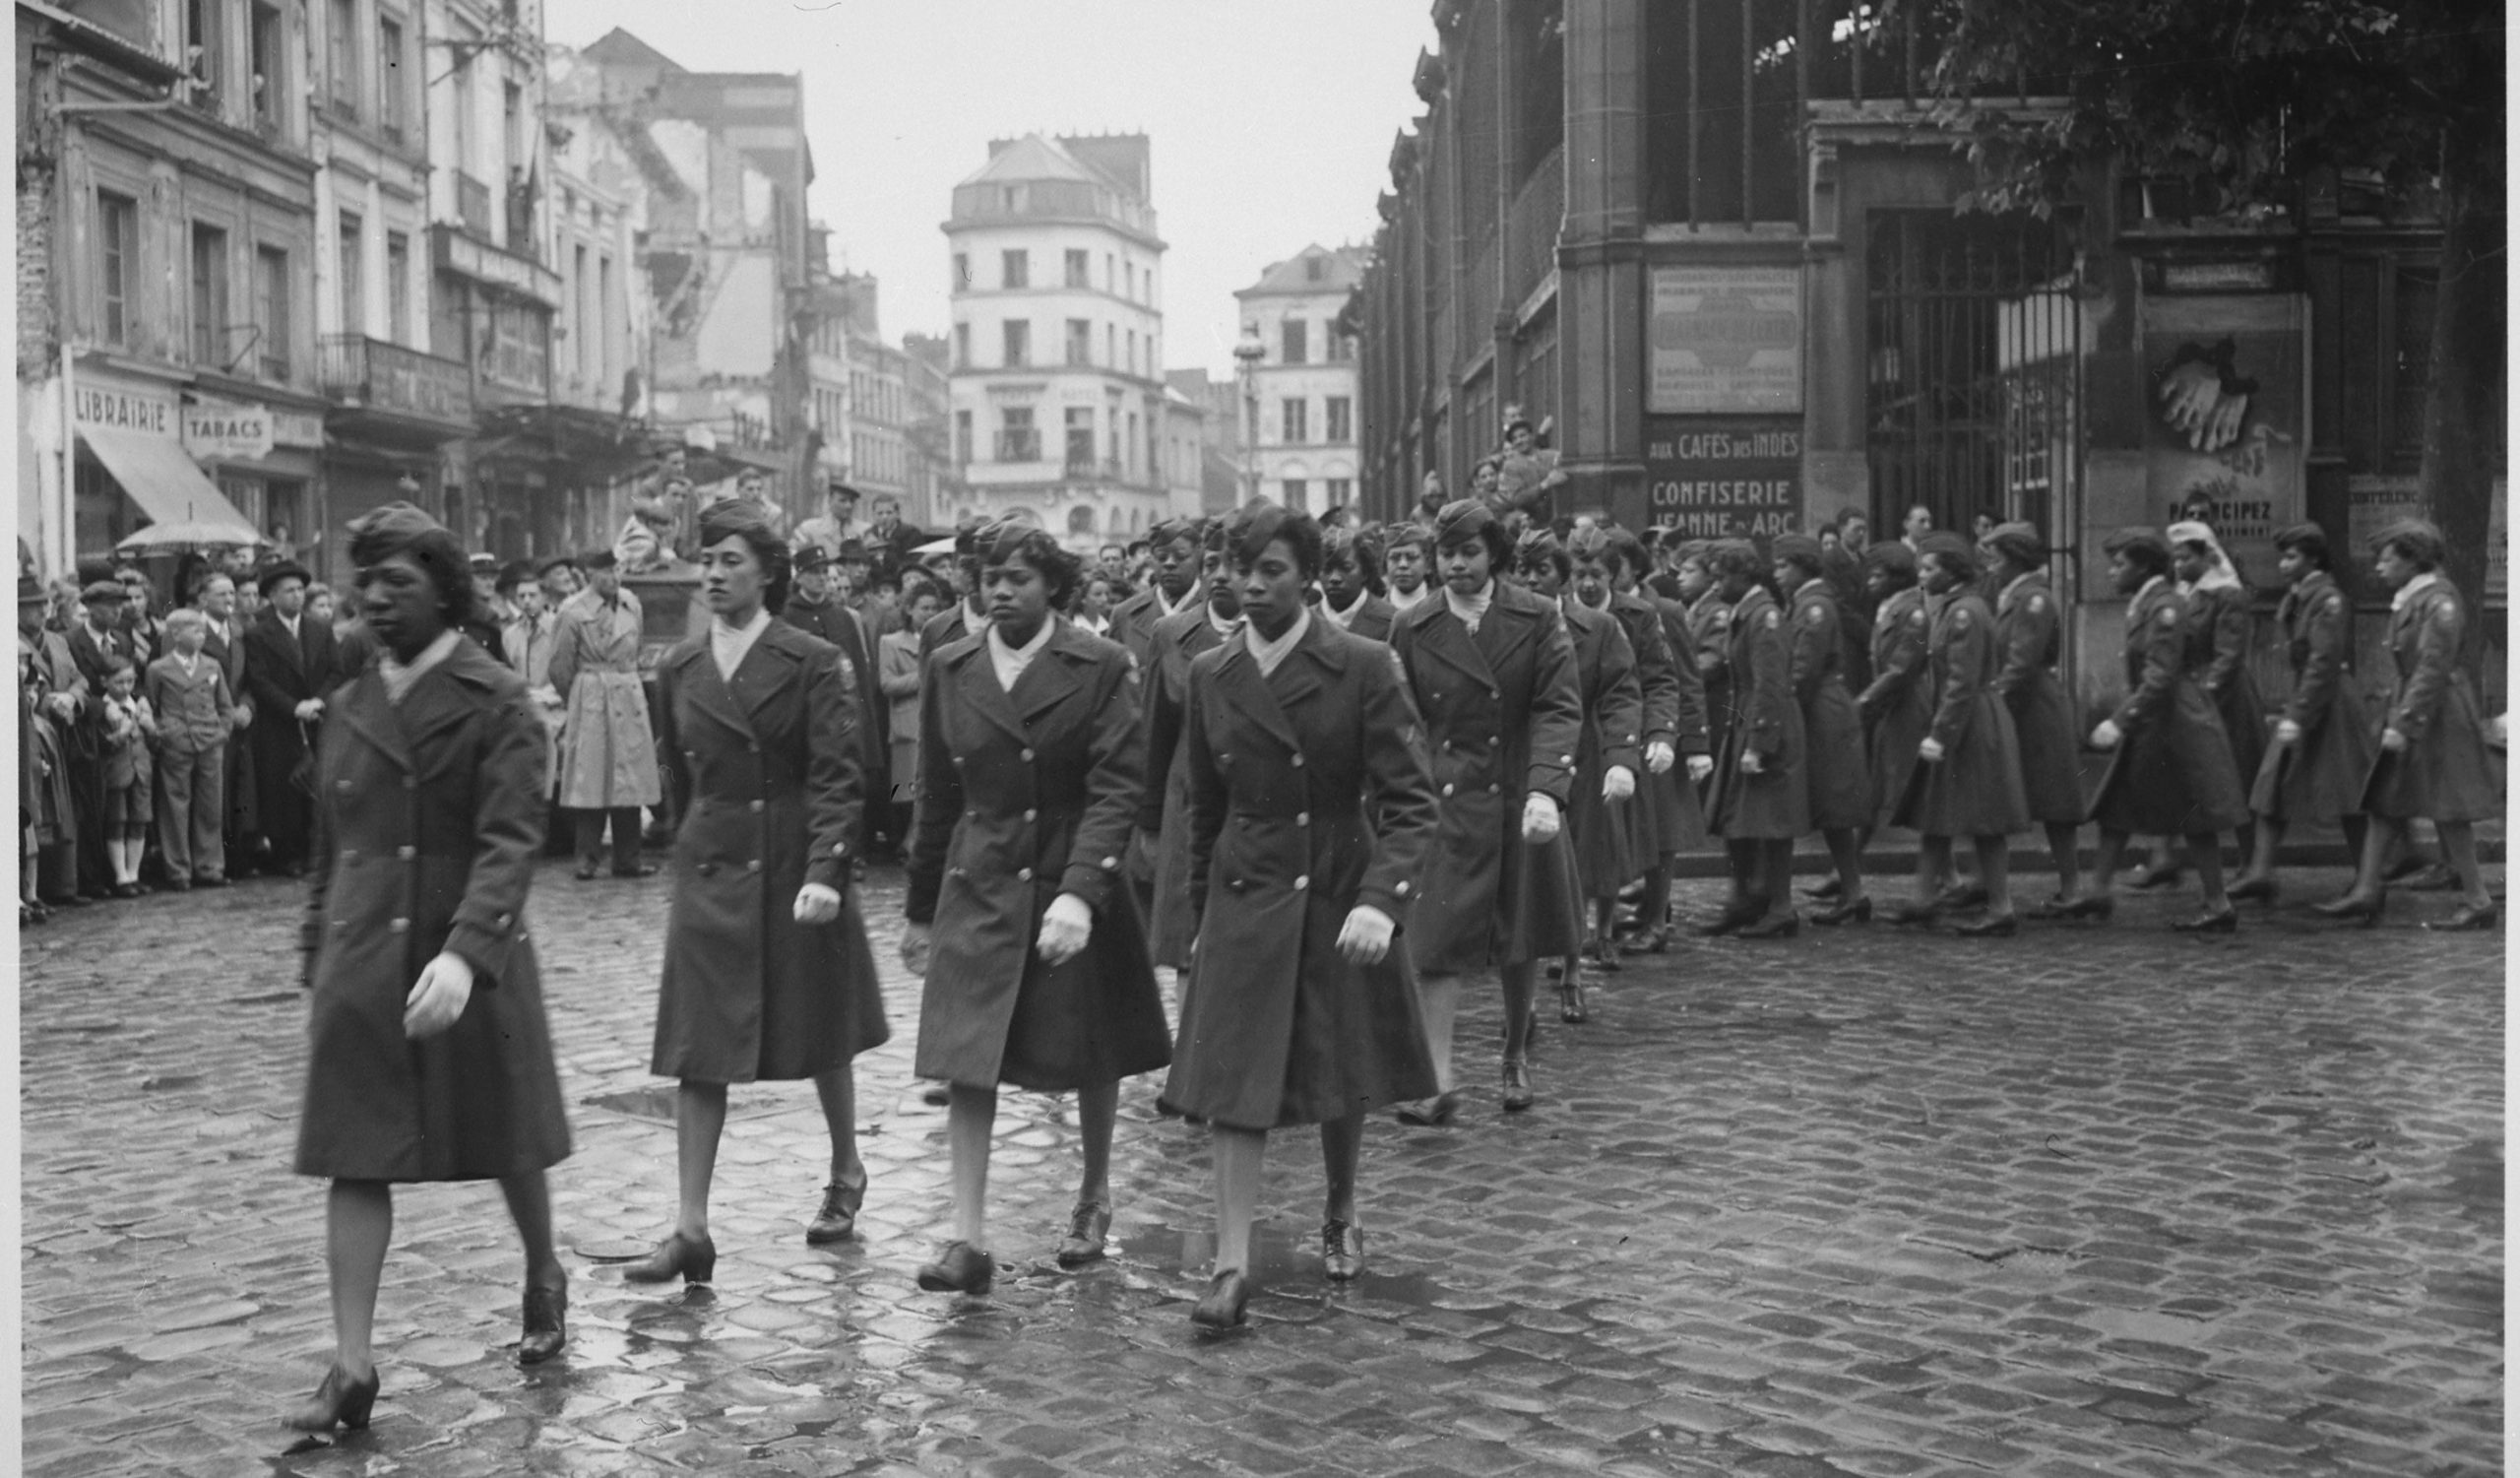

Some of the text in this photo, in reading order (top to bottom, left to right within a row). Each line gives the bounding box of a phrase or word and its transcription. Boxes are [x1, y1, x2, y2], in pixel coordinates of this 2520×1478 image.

[190, 420, 263, 438] TABACS
[1650, 442, 1673, 459] AUX
[1753, 432, 1799, 458] INDES
[1653, 481, 1791, 506] CONFISERIE
